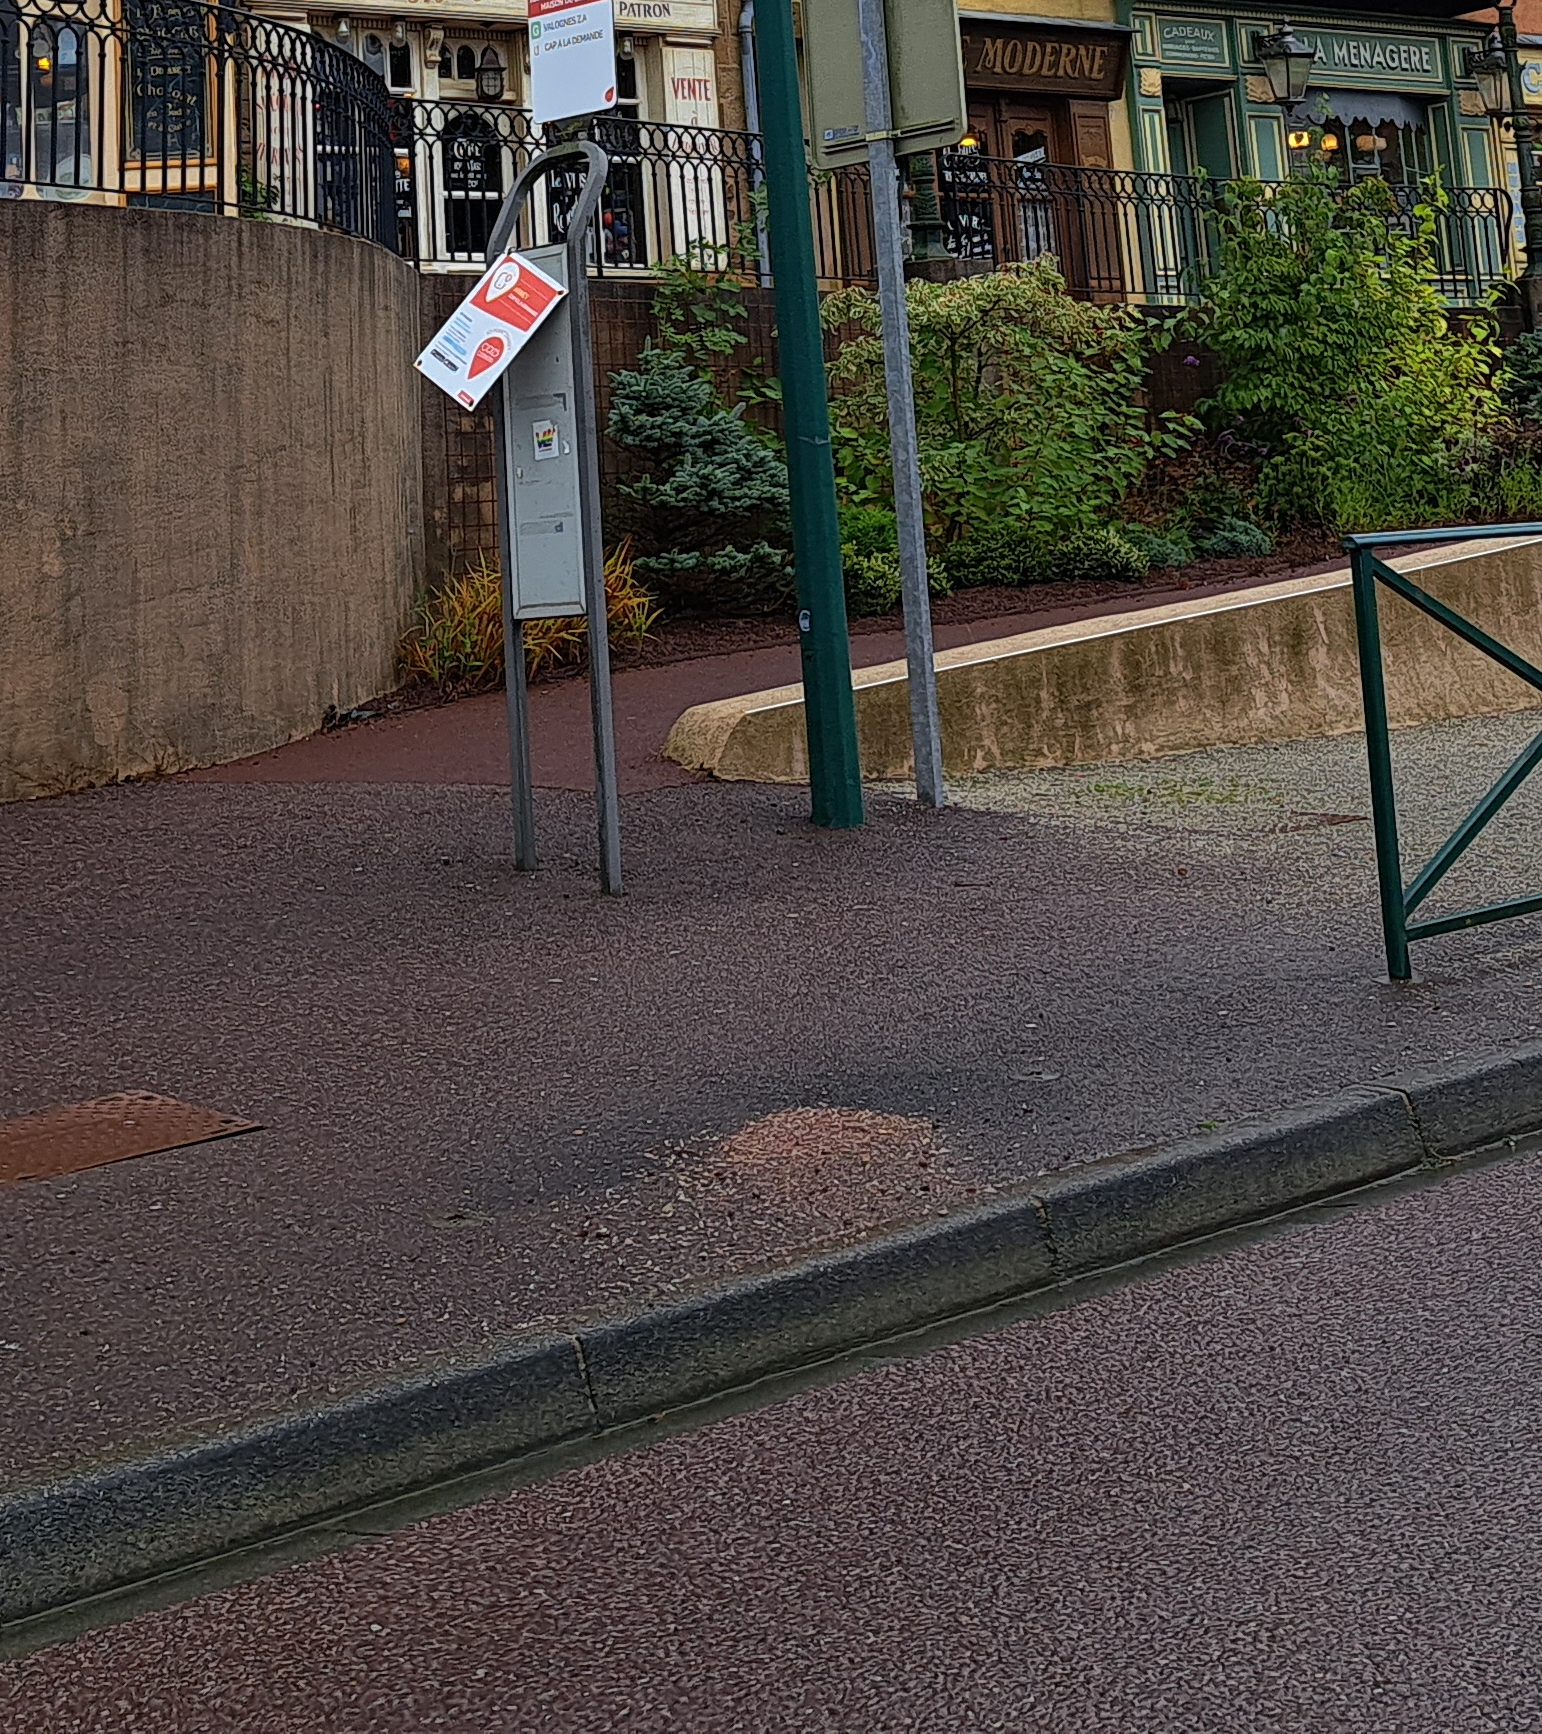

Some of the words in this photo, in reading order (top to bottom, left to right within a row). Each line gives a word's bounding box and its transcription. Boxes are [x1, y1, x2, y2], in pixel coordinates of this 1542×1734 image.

[619, 1, 671, 19] PATRON
[1163, 26, 1215, 42] CADEAUX
[974, 36, 1109, 80] MODERNE
[1331, 37, 1432, 73] MENAGERE
[671, 77, 712, 102] VENTE
